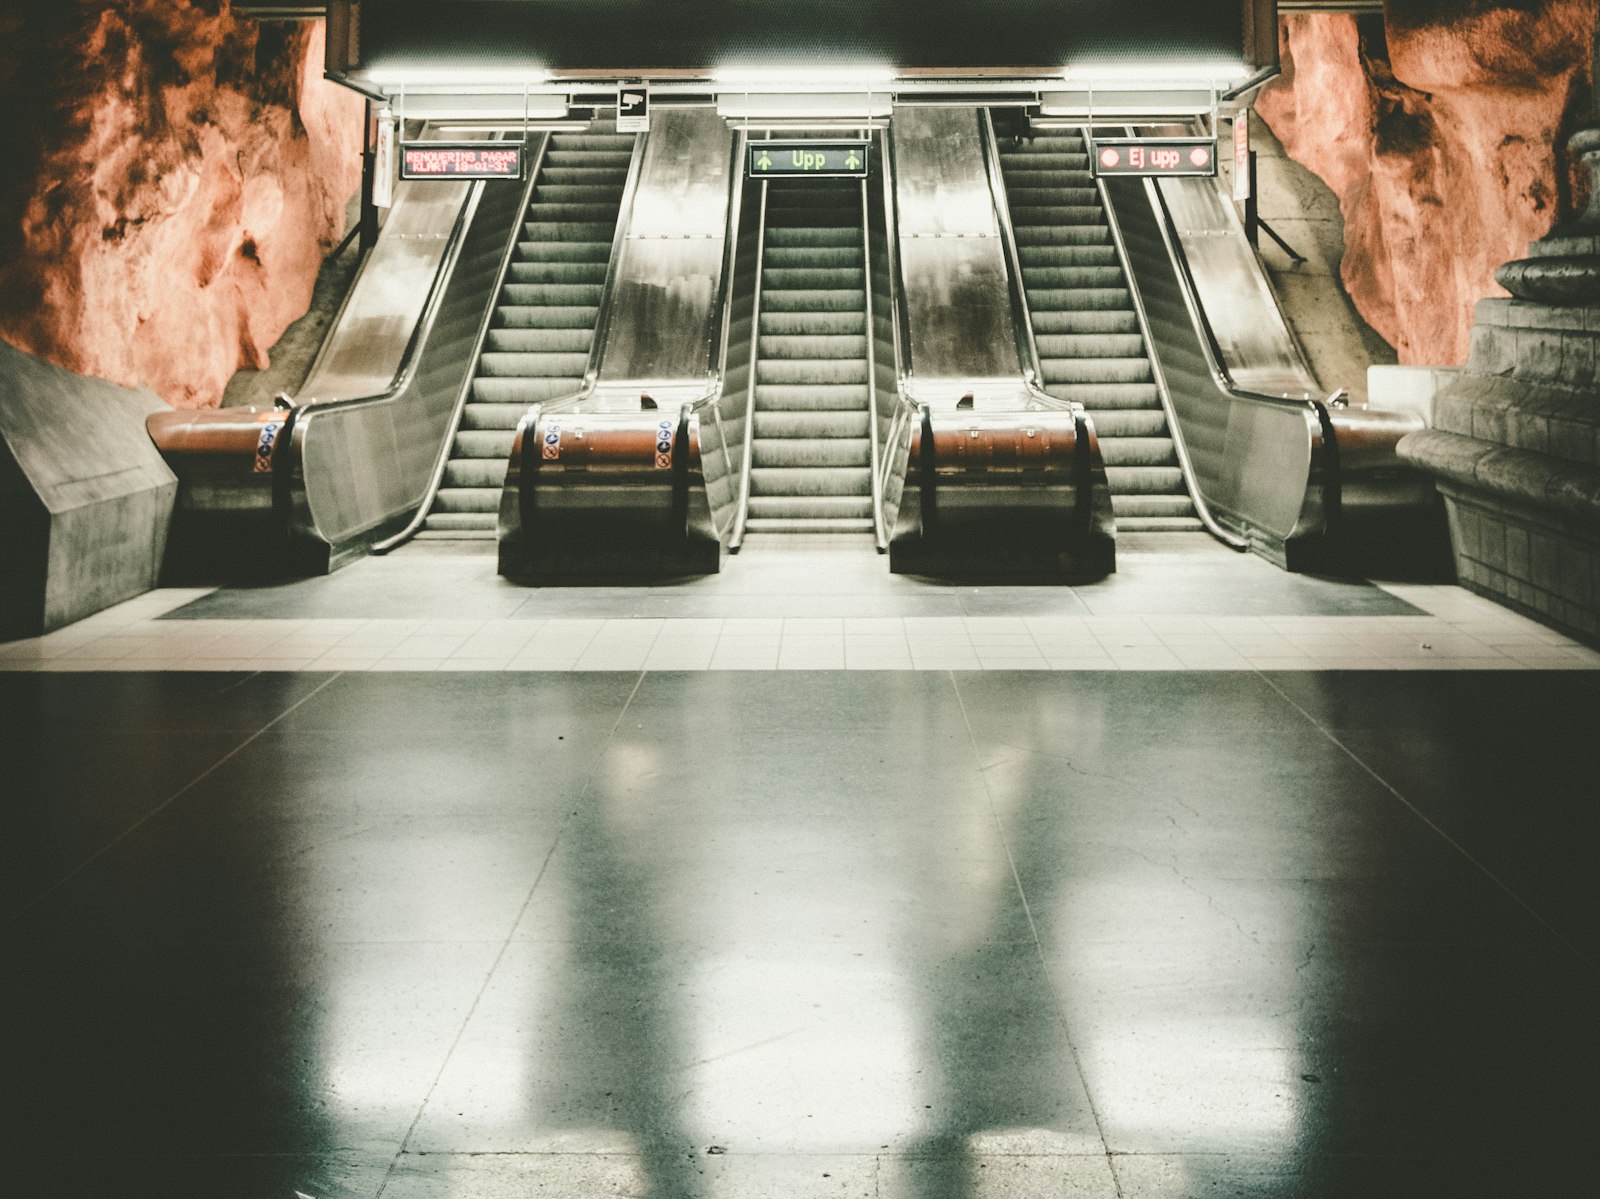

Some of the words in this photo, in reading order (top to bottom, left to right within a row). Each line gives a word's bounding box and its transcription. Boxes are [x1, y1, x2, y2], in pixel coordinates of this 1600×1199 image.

[792, 150, 826, 170] Upp
[1129, 148, 1145, 169] Ej
[1151, 150, 1180, 169] upp
